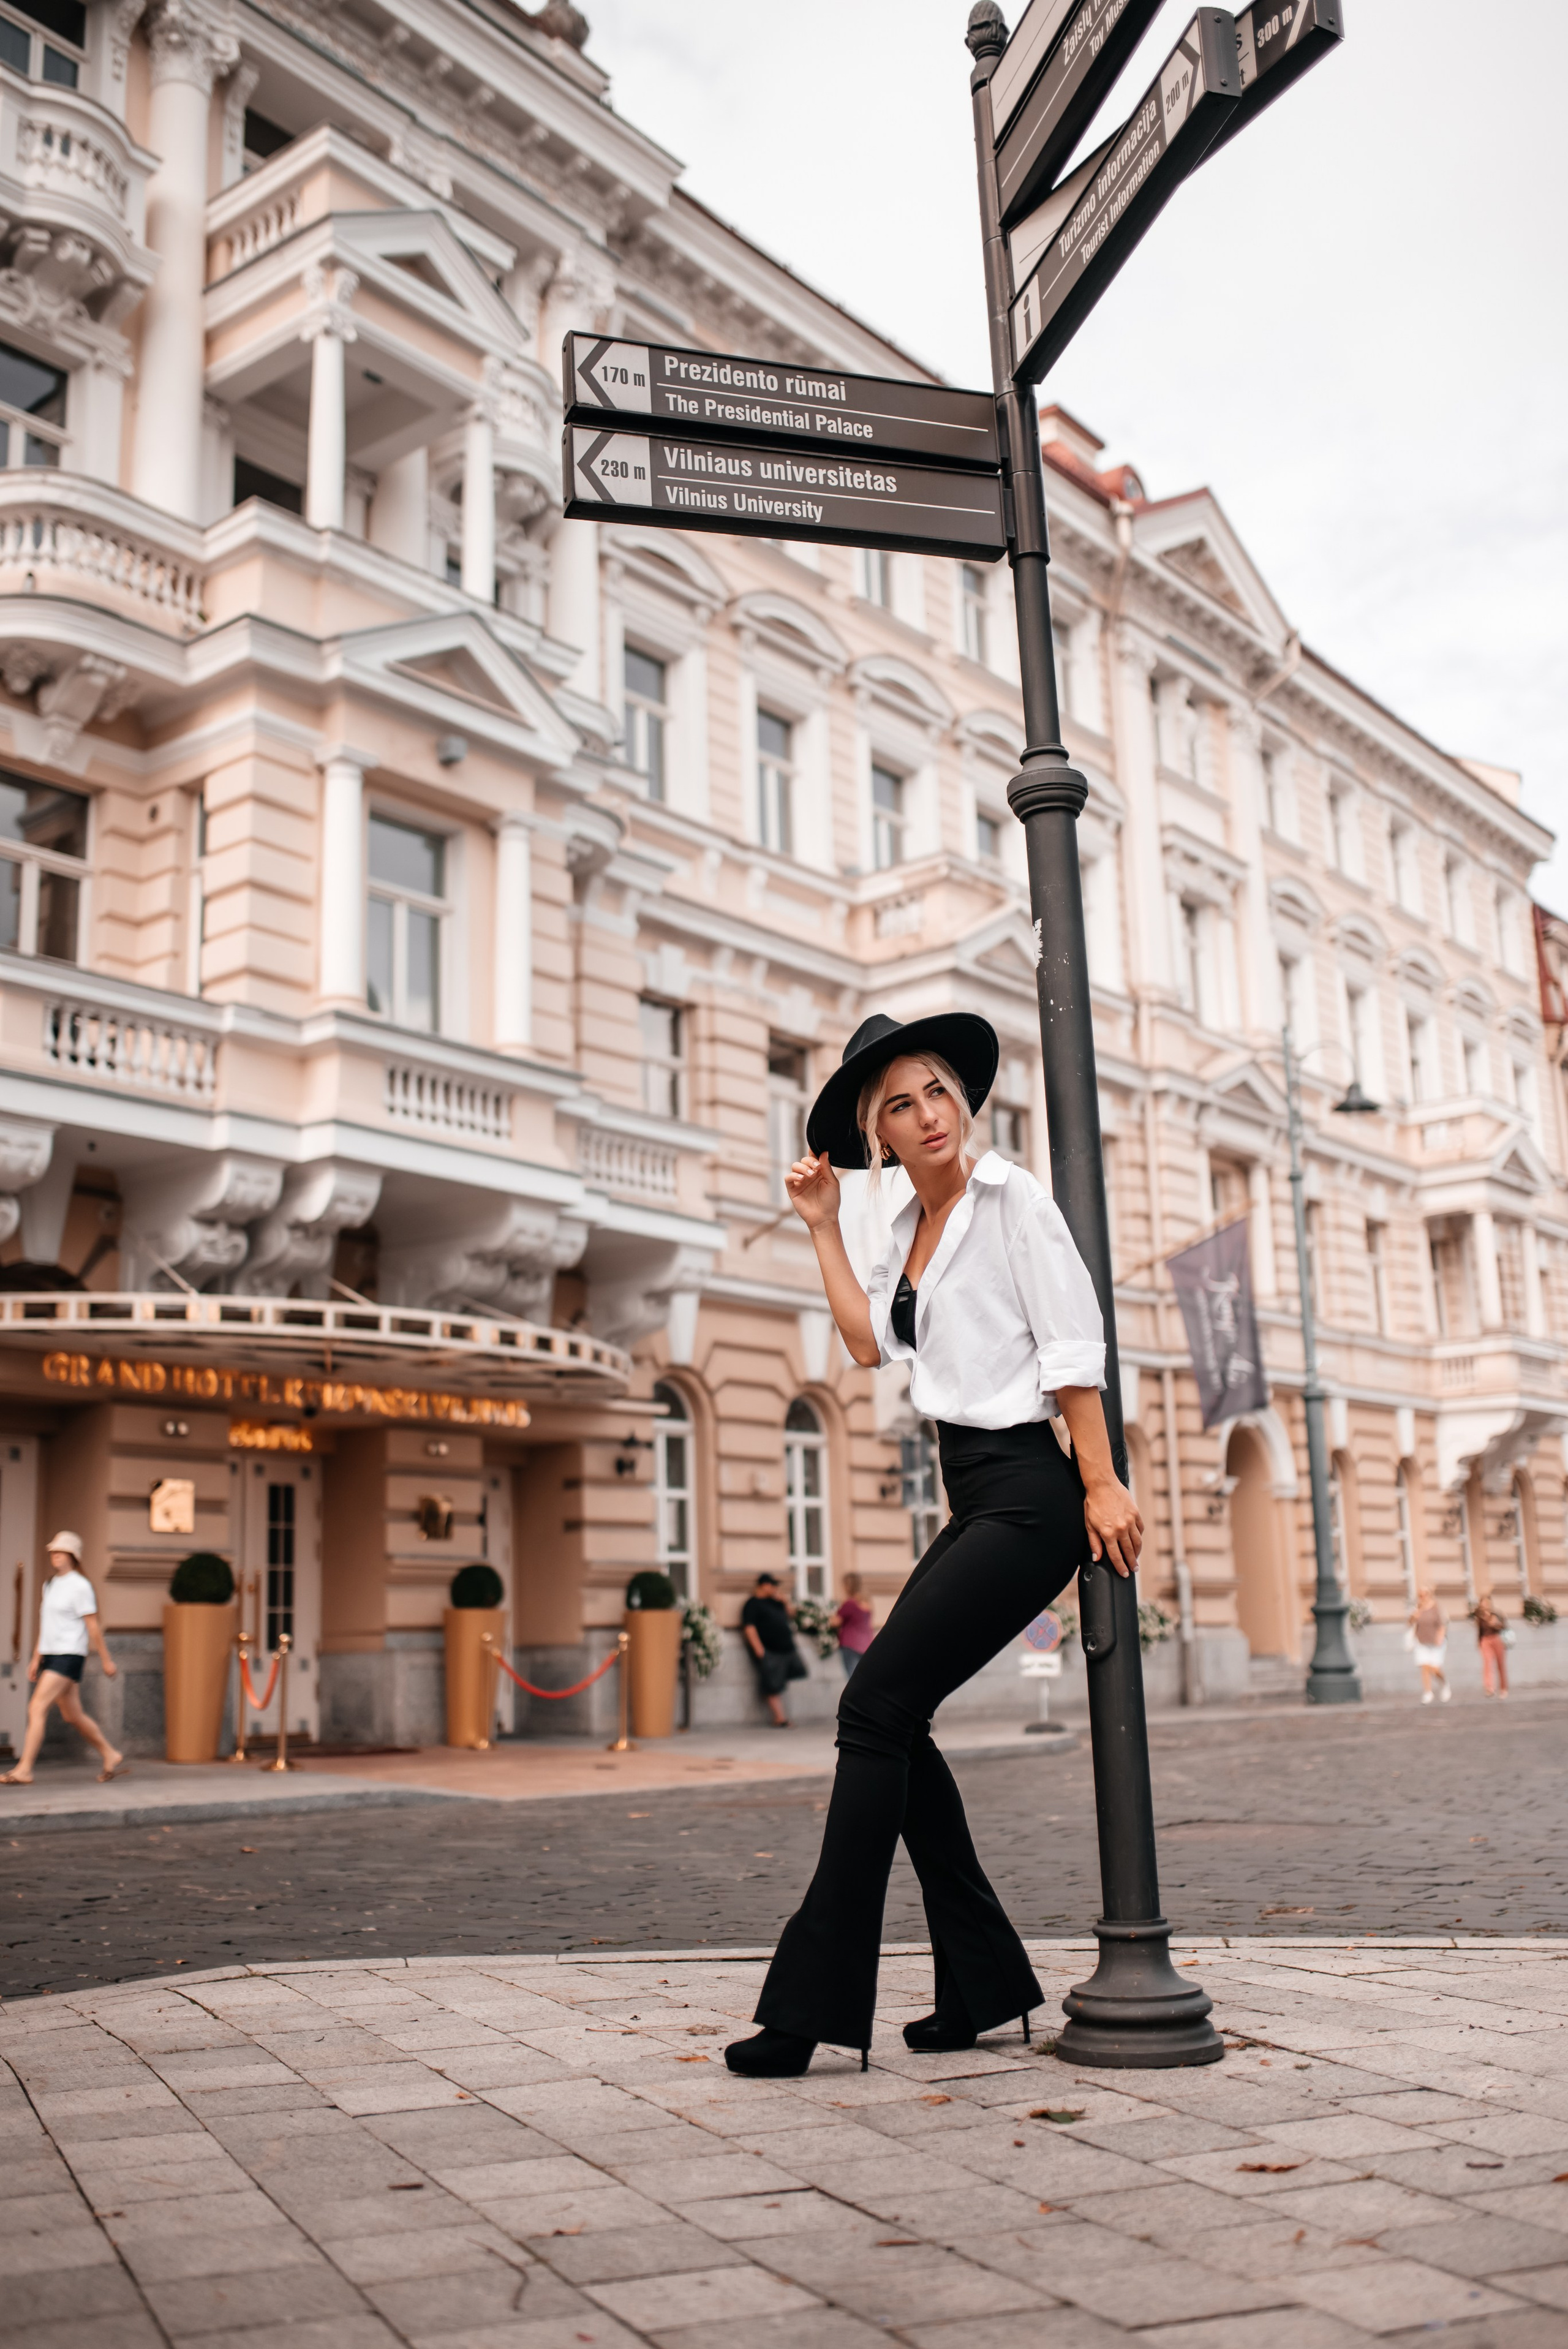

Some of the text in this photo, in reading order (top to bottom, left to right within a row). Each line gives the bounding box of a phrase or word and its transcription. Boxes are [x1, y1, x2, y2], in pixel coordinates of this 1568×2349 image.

[1063, 6, 1093, 66] Žaislų
[1089, 26, 1104, 57] Toy
[1106, 0, 1126, 32] Mus
[1257, 15, 1280, 48] 300
[1282, 5, 1293, 26] m
[1166, 70, 1189, 116] 200 m
[1058, 100, 1157, 258] Turizmo informacija
[1080, 140, 1160, 264] Tourist Information
[601, 366, 646, 387] 170 m
[664, 355, 846, 401] Prezidento rūmai
[665, 393, 873, 439] The Presidential Palace
[601, 459, 646, 480] 230 m
[663, 446, 897, 492] Vilniaus universitetas
[665, 485, 823, 523] Vilnius University
[42, 1352, 167, 1393] GRAND
